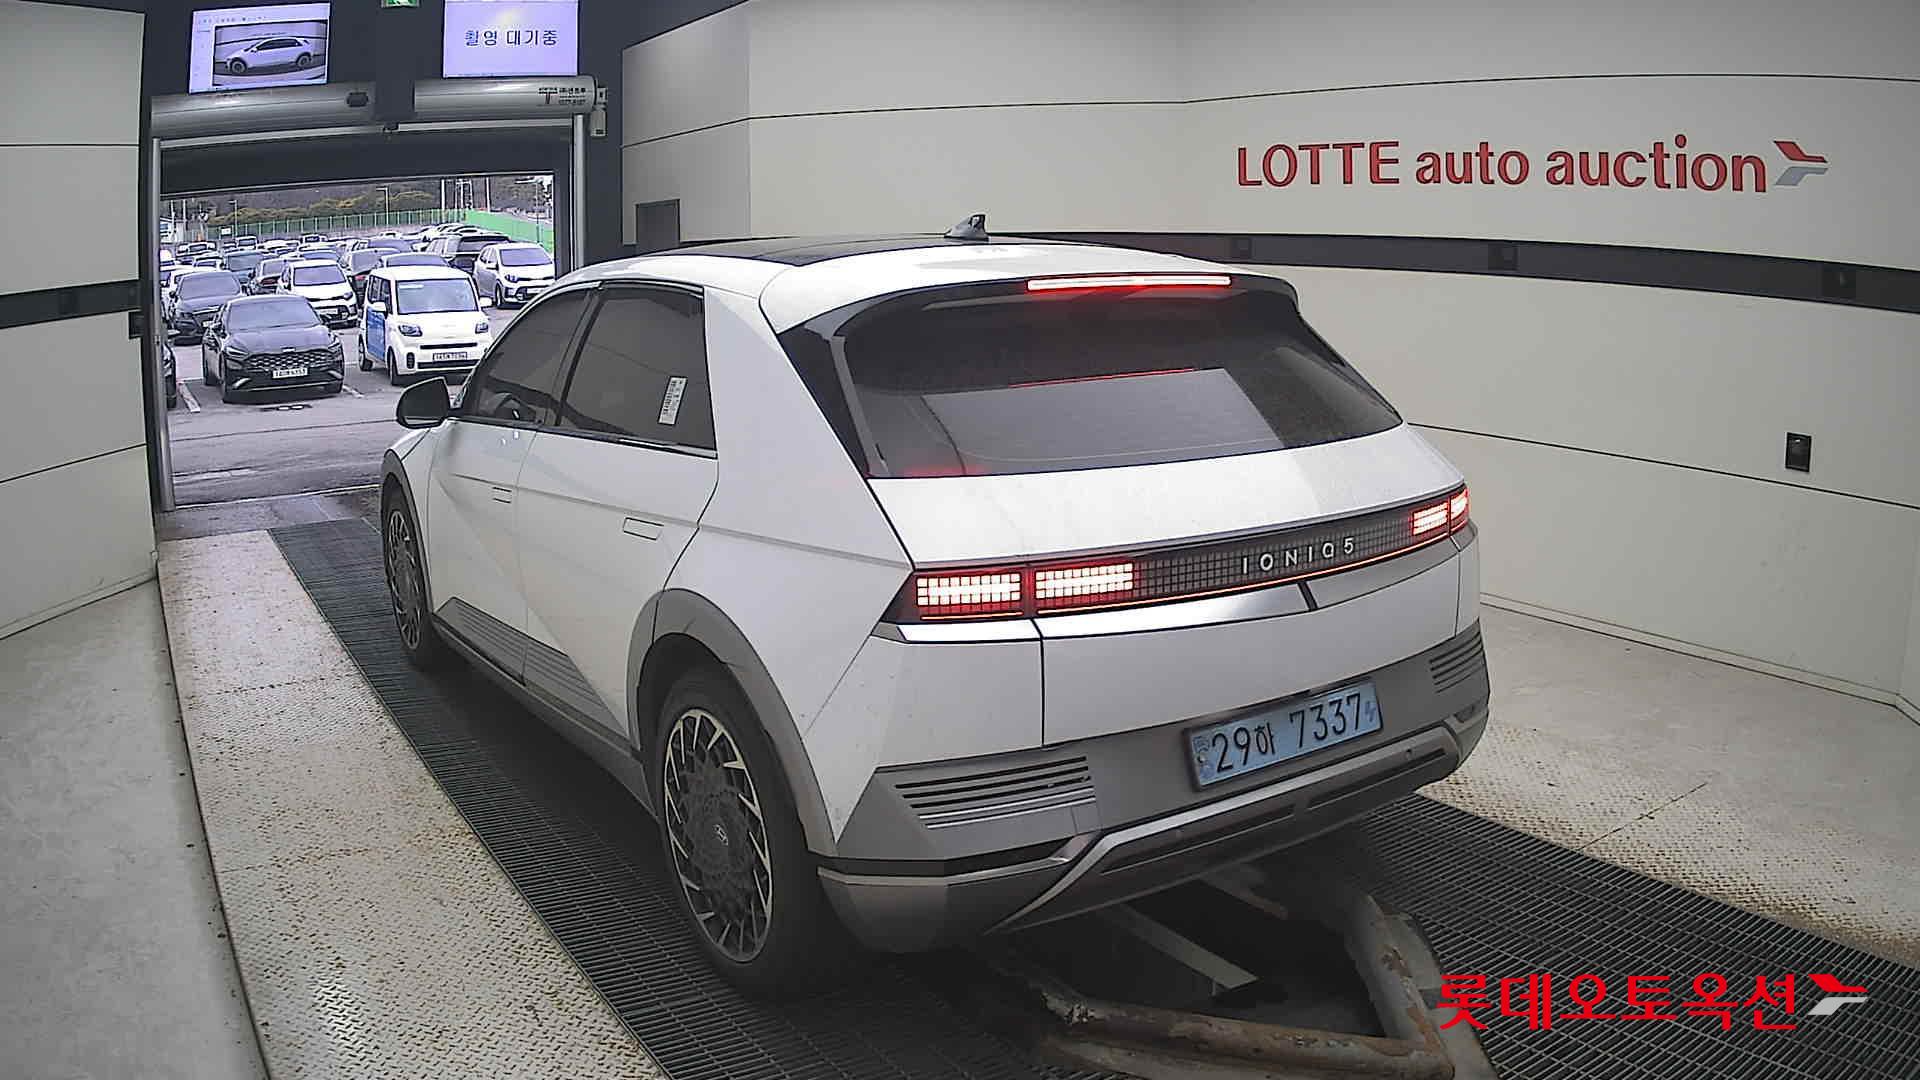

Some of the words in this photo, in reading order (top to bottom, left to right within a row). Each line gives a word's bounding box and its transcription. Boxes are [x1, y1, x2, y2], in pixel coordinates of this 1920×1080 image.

[506, 29, 558, 47] 대기중
[1238, 140, 1400, 187] LOTTE
[1415, 141, 1530, 186] auto
[1545, 134, 1767, 193] auction
[1212, 721, 1276, 773] 29하
[1289, 692, 1361, 749] 7337
